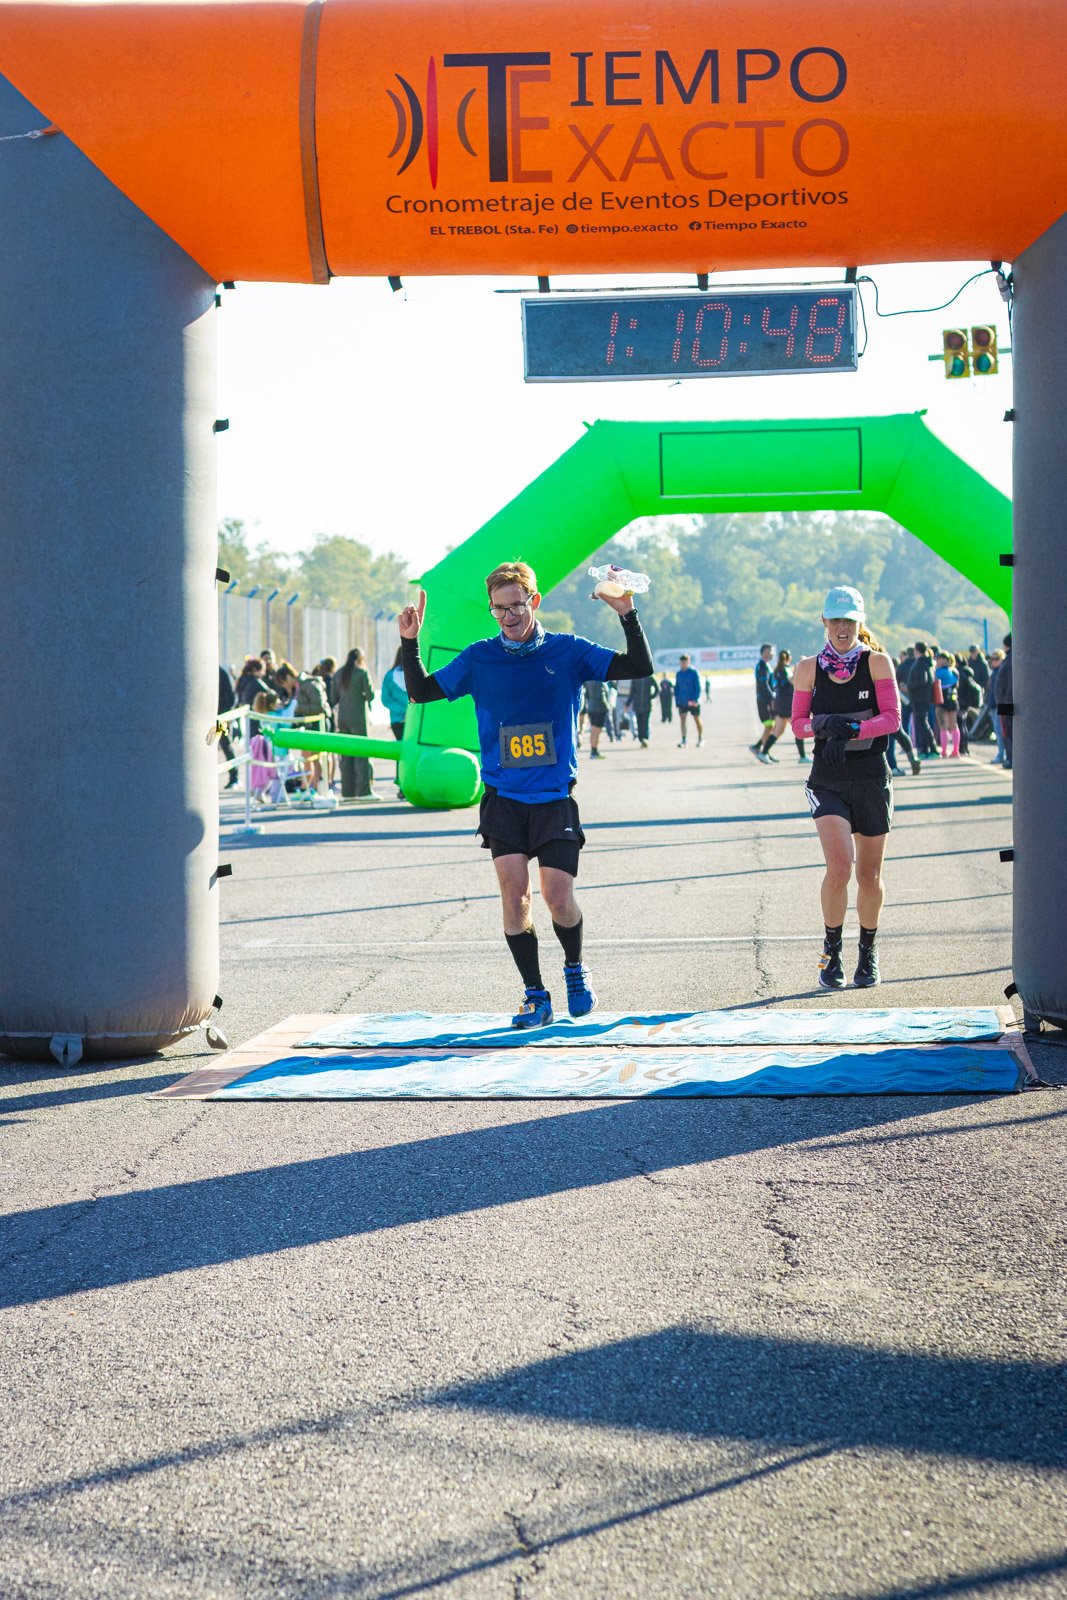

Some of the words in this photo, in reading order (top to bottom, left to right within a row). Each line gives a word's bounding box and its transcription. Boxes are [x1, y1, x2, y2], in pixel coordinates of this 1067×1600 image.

[386, 193, 555, 216] Cronometraje
[562, 191, 593, 210] de
[601, 191, 700, 210] Eventos
[708, 188, 849, 211] Deportivos
[430, 226, 446, 235] EL
[448, 225, 501, 235] TREBOL
[505, 224, 535, 235] (Sta.
[539, 224, 559, 235] Fe)
[581, 223, 679, 235] tiempo.exacto
[704, 220, 757, 232] Tiempo
[761, 219, 807, 229] Exacto
[510, 734, 546, 758] 685
